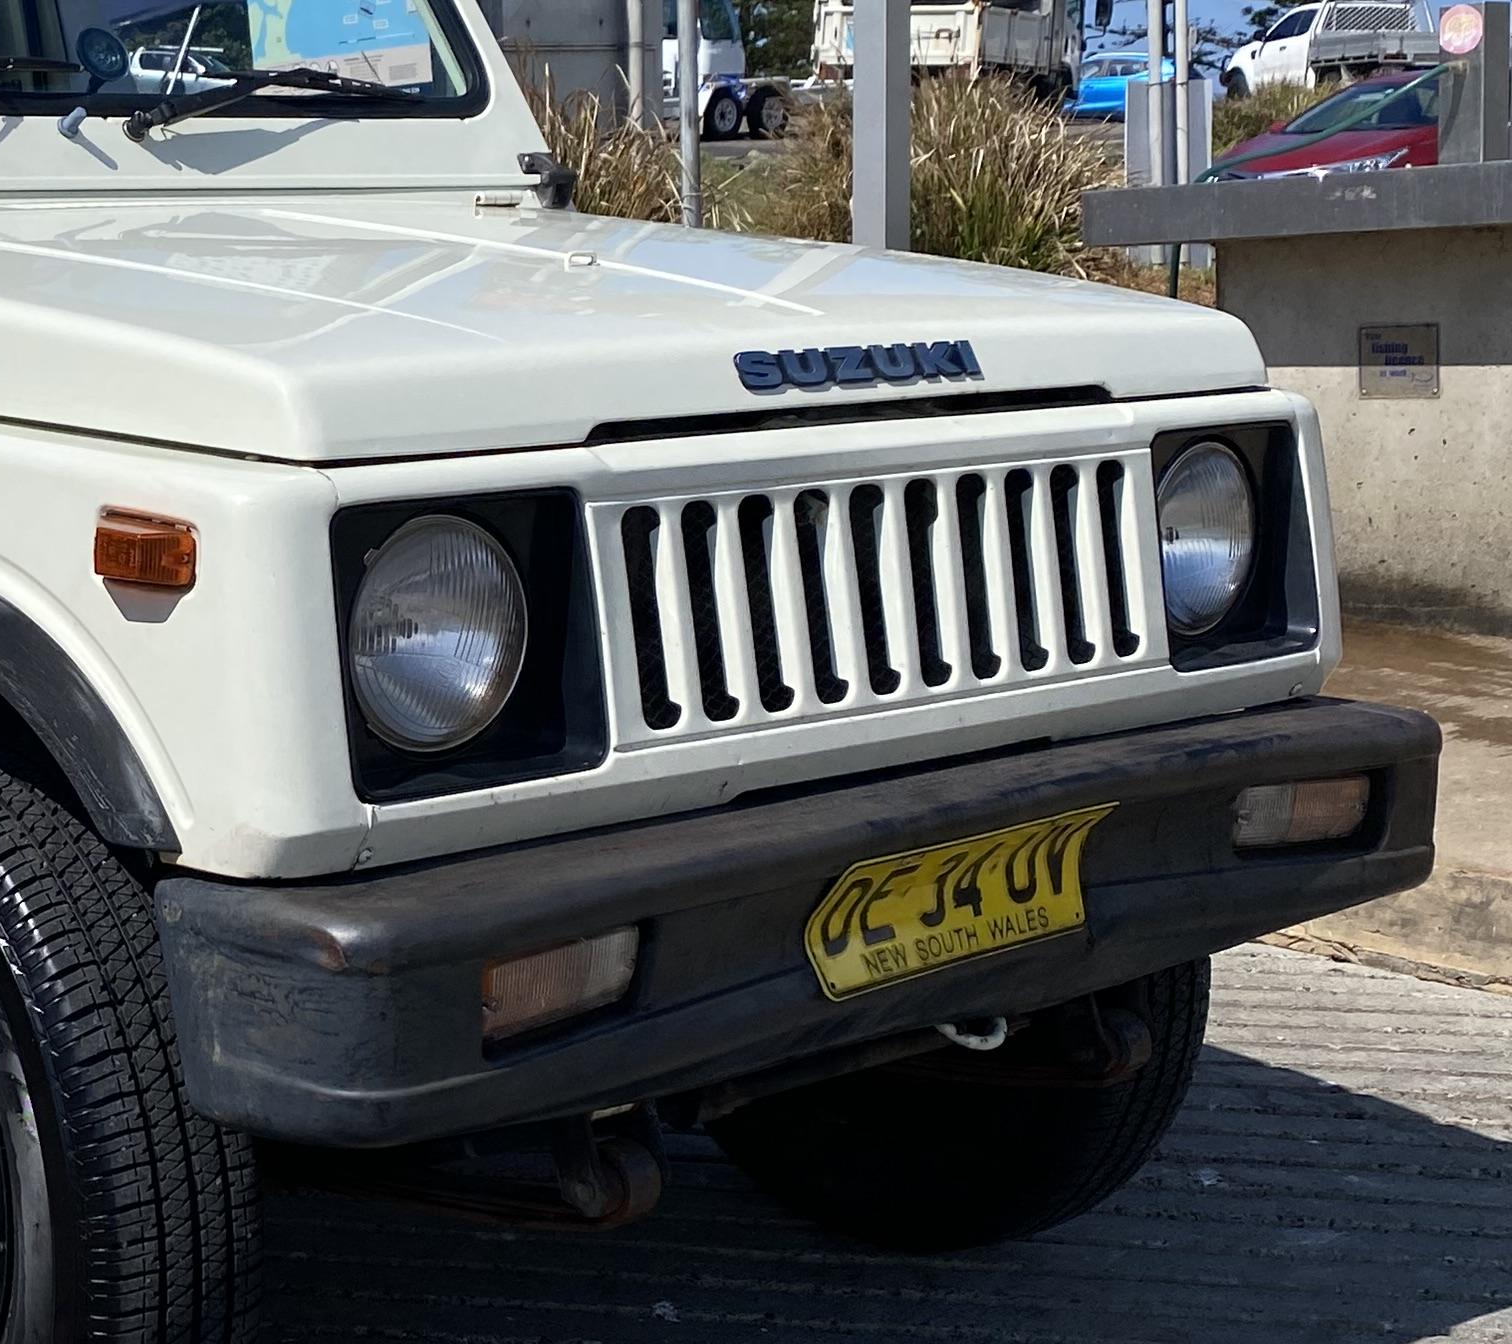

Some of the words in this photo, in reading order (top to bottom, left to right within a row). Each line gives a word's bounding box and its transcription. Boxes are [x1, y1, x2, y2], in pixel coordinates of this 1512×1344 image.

[734, 340, 982, 390] SUZUKI
[862, 943, 907, 977] NEW
[916, 924, 979, 962] SOUTH
[988, 906, 1050, 939] WALES
